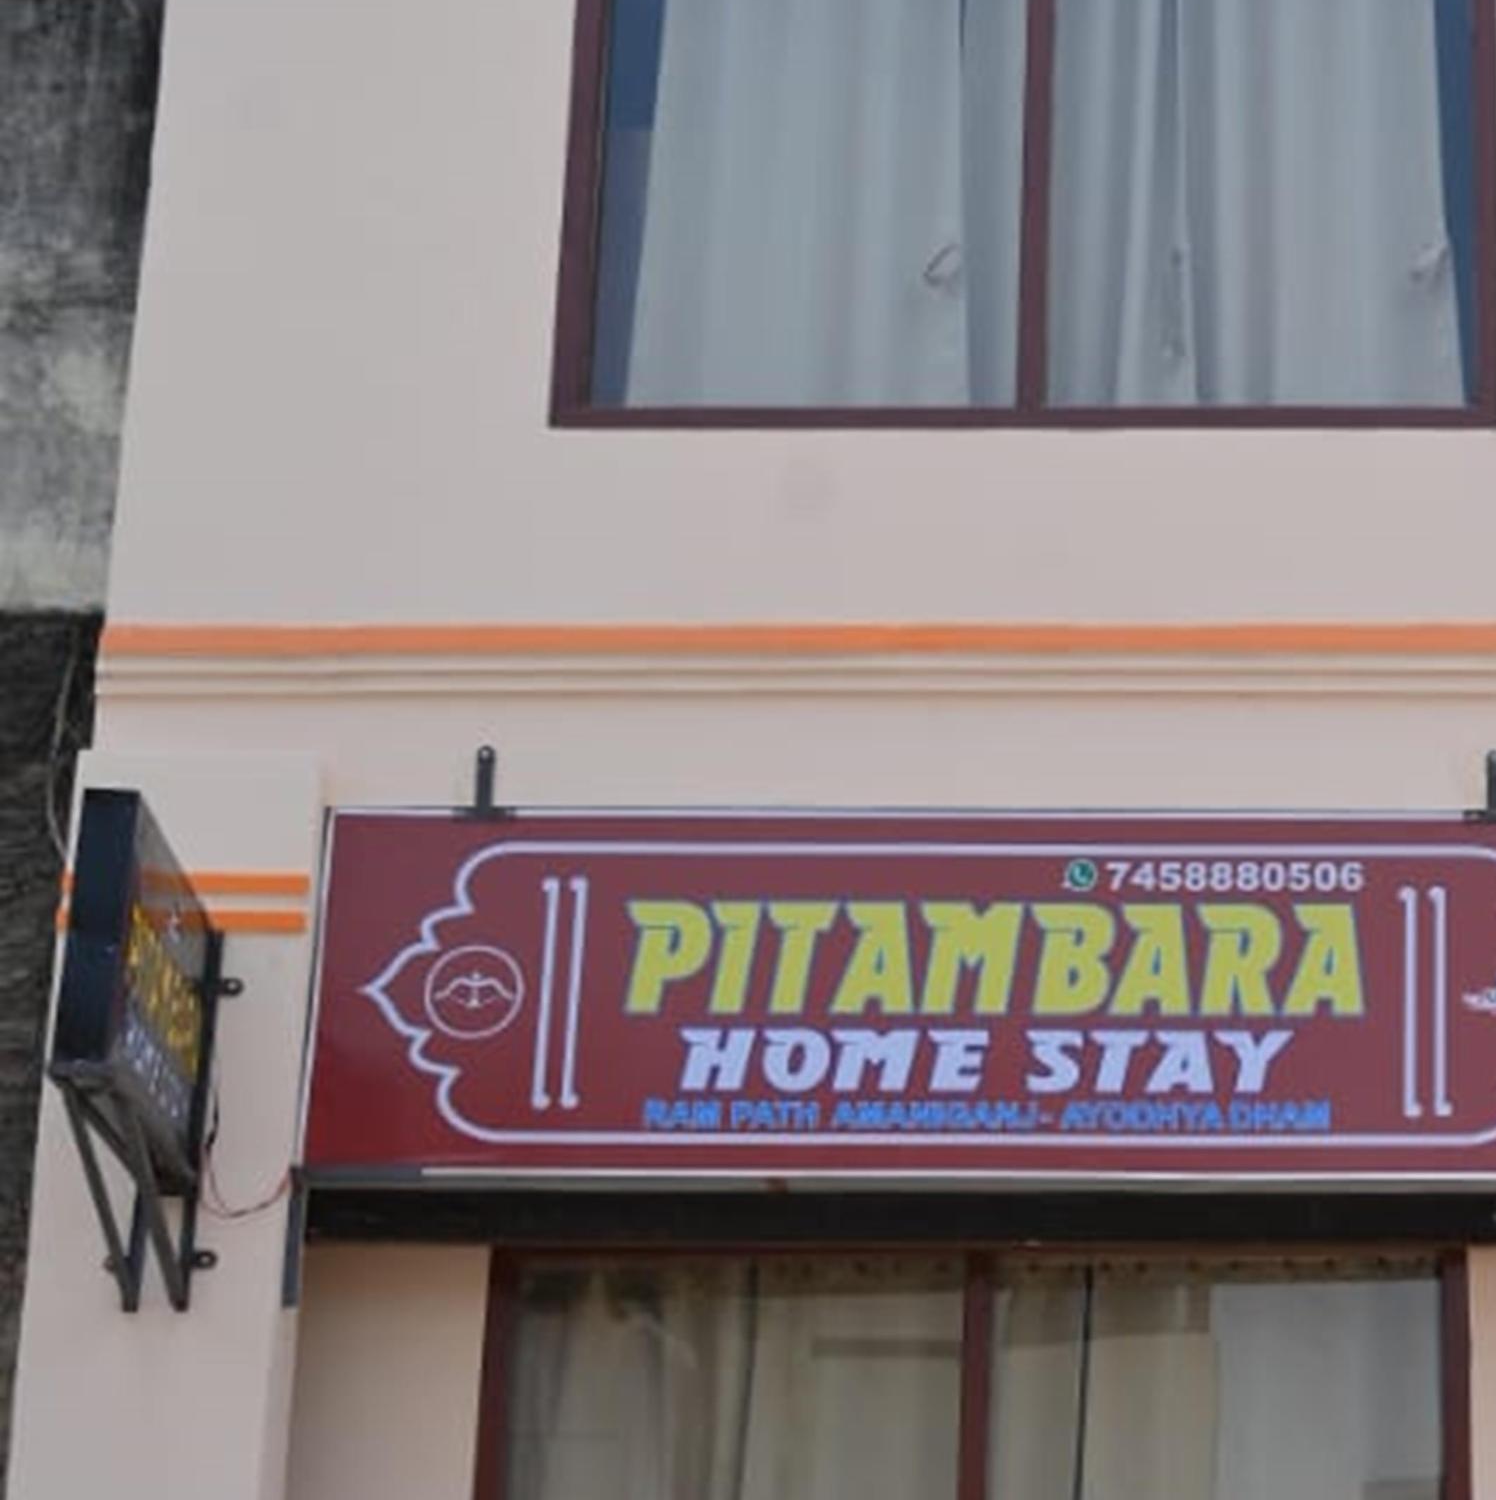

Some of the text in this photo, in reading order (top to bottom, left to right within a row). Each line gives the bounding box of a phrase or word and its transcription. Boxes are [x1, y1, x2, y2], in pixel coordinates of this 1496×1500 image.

[1106, 862, 1364, 891] 7458880506
[624, 900, 1365, 1016] PITAMBARA
[680, 1028, 1294, 1093] HOME STAY
[644, 1100, 722, 1127] RAM
[730, 1100, 819, 1128] PATH
